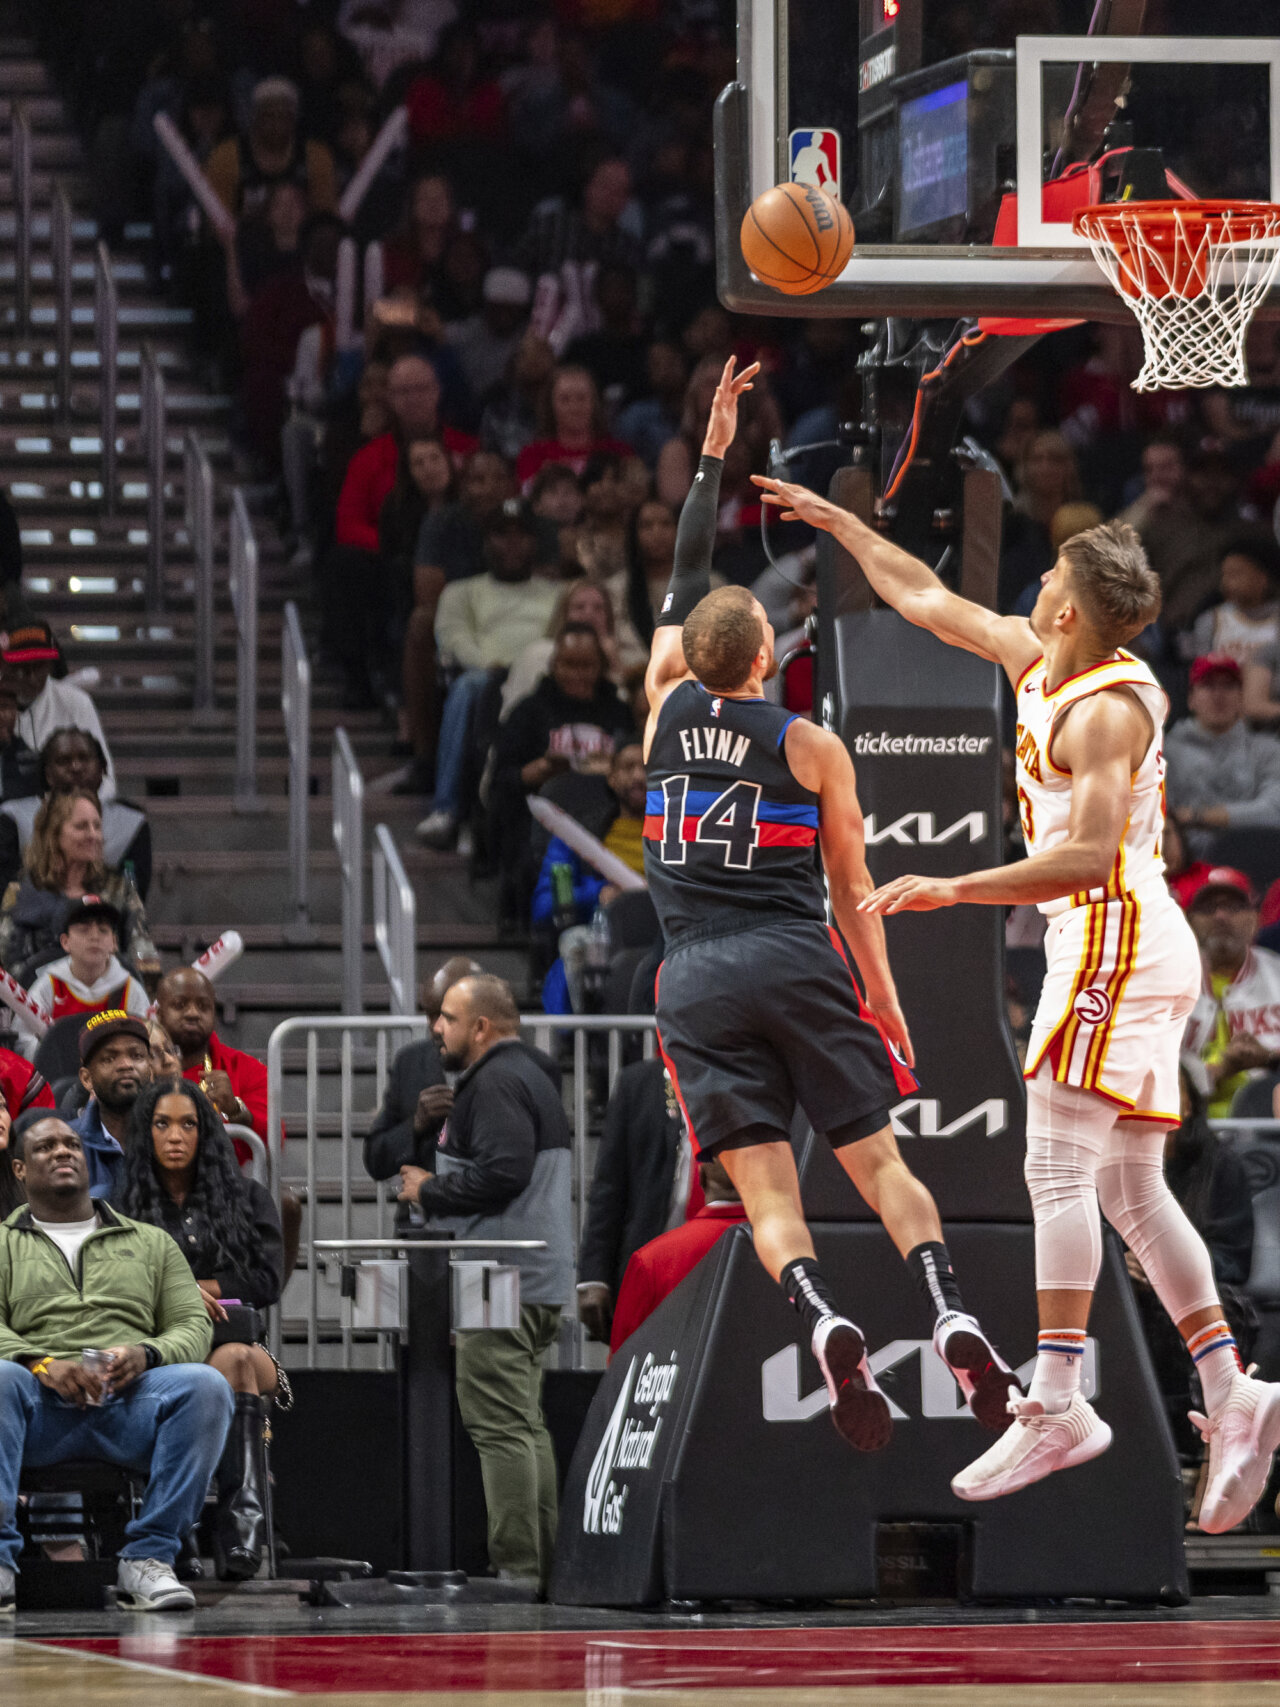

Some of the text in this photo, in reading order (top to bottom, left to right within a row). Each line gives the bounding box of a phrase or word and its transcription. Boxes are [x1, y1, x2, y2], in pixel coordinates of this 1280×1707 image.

[679, 727, 751, 767] FLYNN
[854, 732, 990, 755] ticketmaster
[660, 775, 763, 870] 14
[634, 1350, 680, 1418] Georgia
[612, 1416, 664, 1469] Natural
[602, 1479, 625, 1535] Gas
